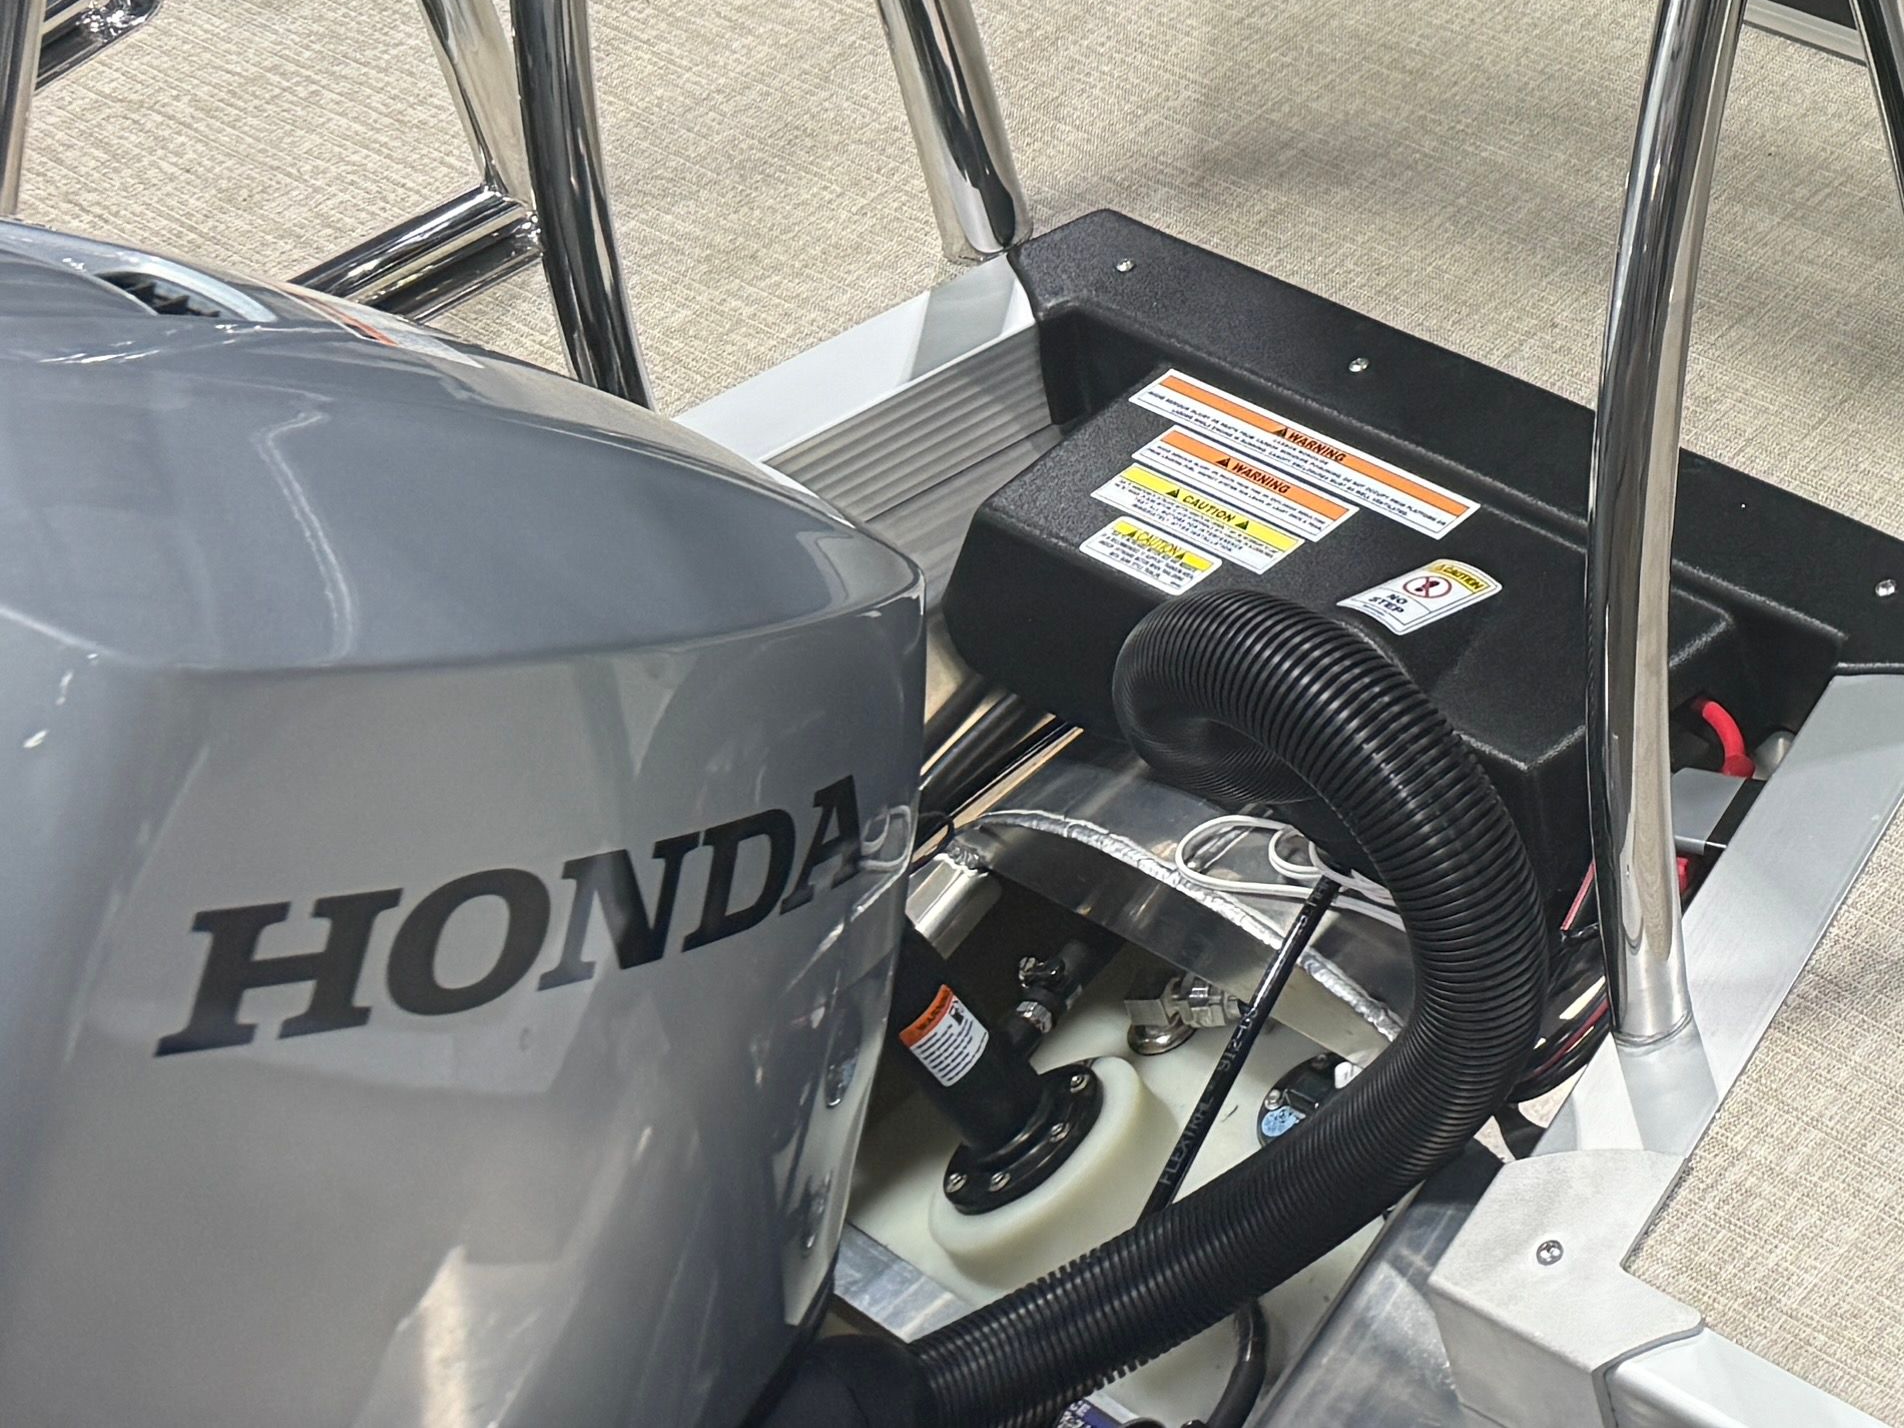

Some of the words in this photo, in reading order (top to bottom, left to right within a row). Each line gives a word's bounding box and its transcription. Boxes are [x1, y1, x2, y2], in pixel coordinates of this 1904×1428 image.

[1288, 431, 1347, 462] WARNING
[1232, 462, 1291, 494] WARNING
[1182, 494, 1236, 523] CAUTION
[1443, 565, 1484, 591] CAUTION
[1368, 596, 1404, 614] STEP
[1386, 593, 1408, 605] NO
[154, 774, 865, 1058] HONDA
